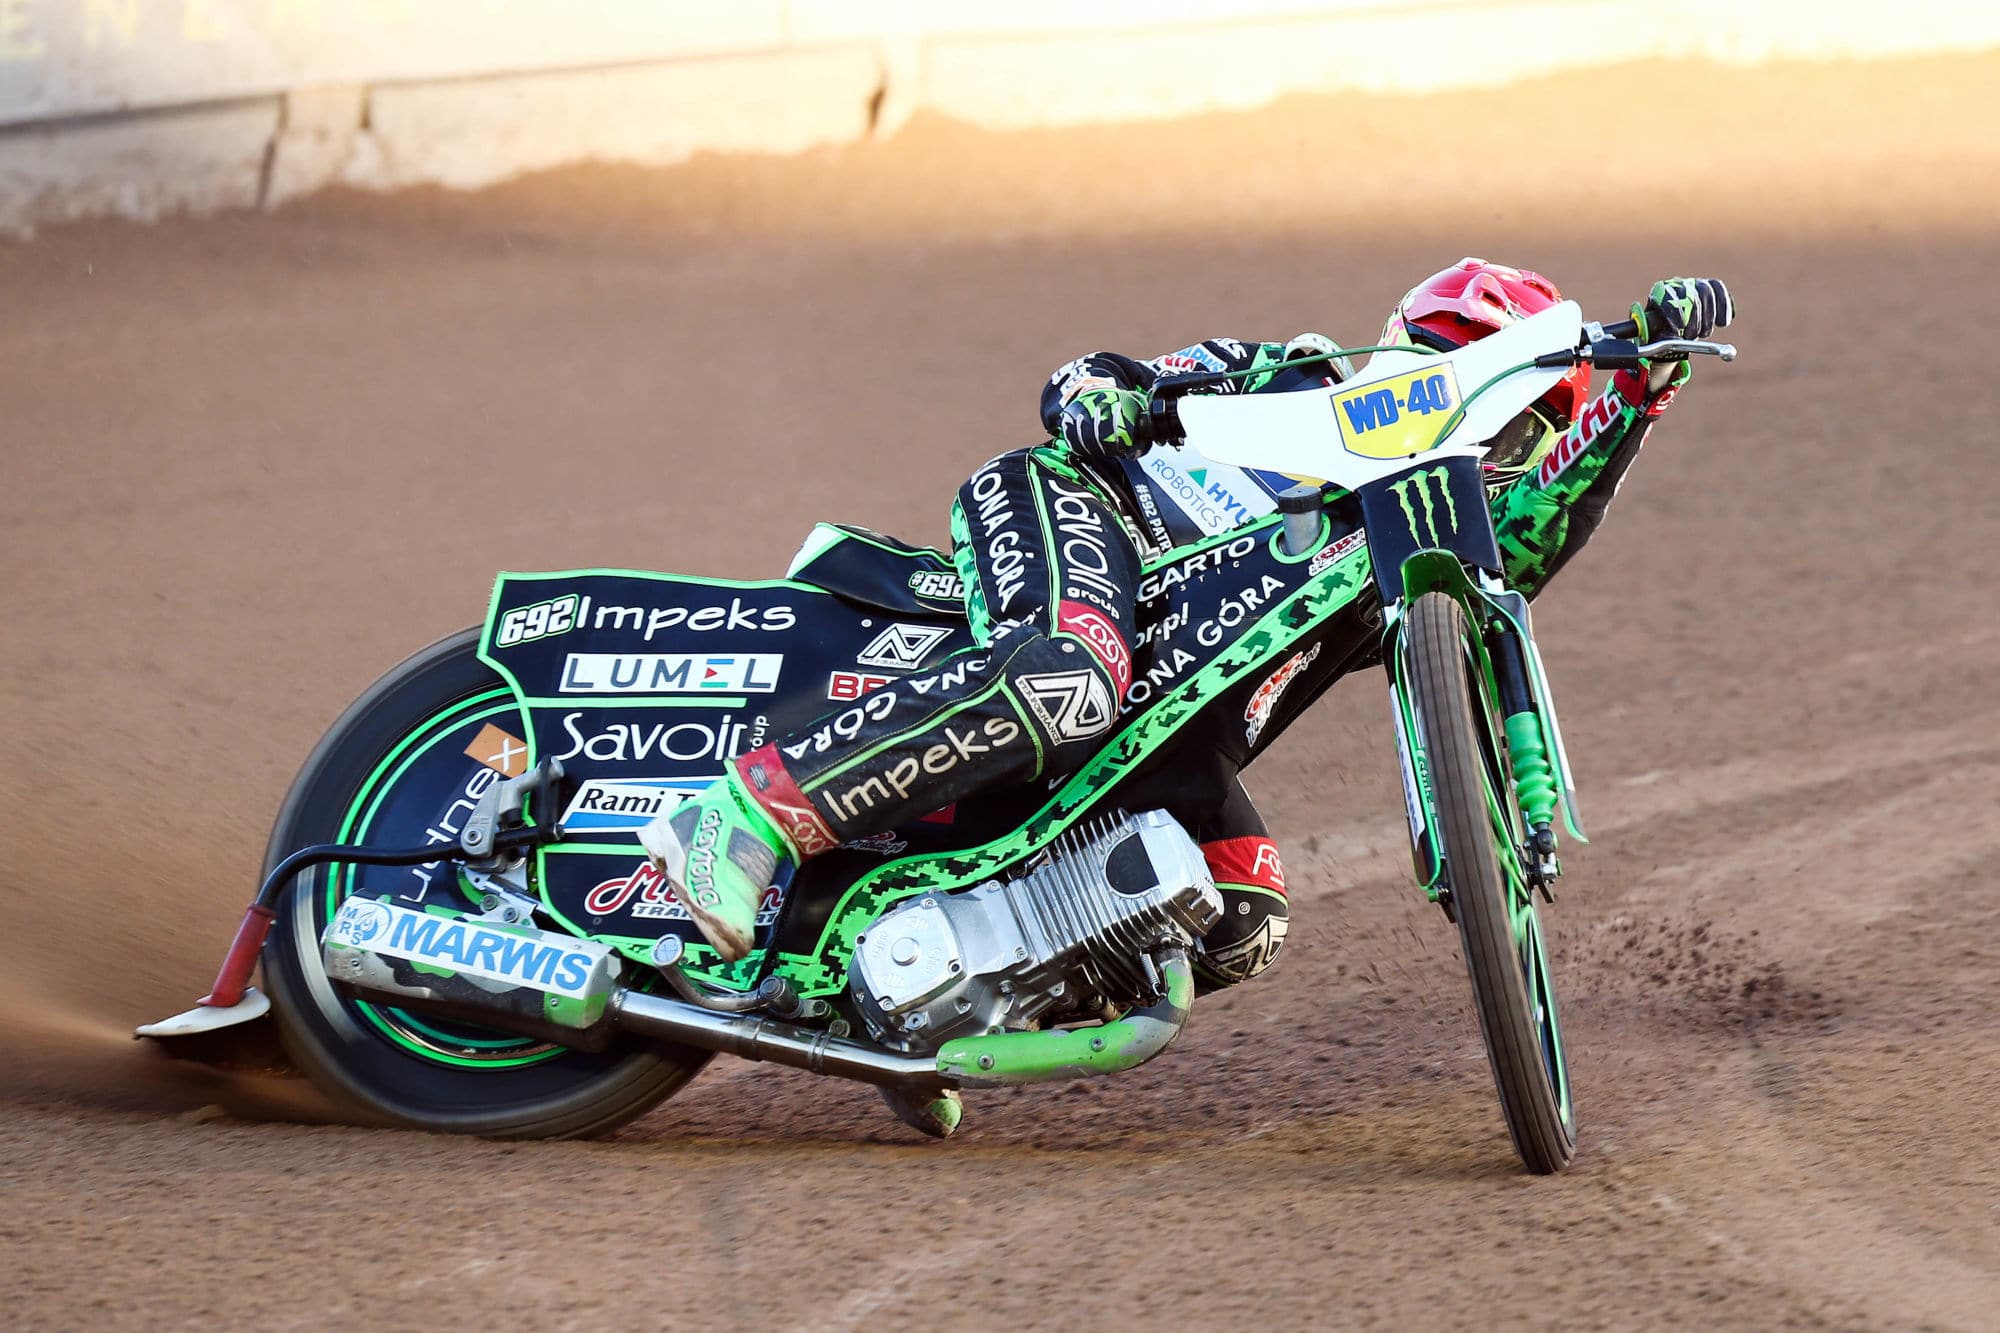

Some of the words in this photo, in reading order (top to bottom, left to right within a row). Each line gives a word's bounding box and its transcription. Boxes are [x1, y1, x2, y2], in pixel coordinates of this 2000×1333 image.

[1343, 374, 1450, 435] WD-40
[1134, 483, 1158, 519] #692
[1149, 517, 1175, 557] PATR
[1151, 458, 1222, 528] ROBOTICS
[988, 530, 1035, 613] GÓRA
[1066, 586, 1120, 621] group
[499, 598, 577, 645] 692
[576, 596, 797, 641] Impeks
[1196, 574, 1286, 647] GÓRA
[566, 658, 772, 688] LUMEL
[783, 690, 898, 760] GÓRA
[580, 788, 664, 813] Rami
[823, 716, 1020, 822] Impeks
[691, 809, 722, 908] daytona
[389, 913, 594, 992] MARWIS
